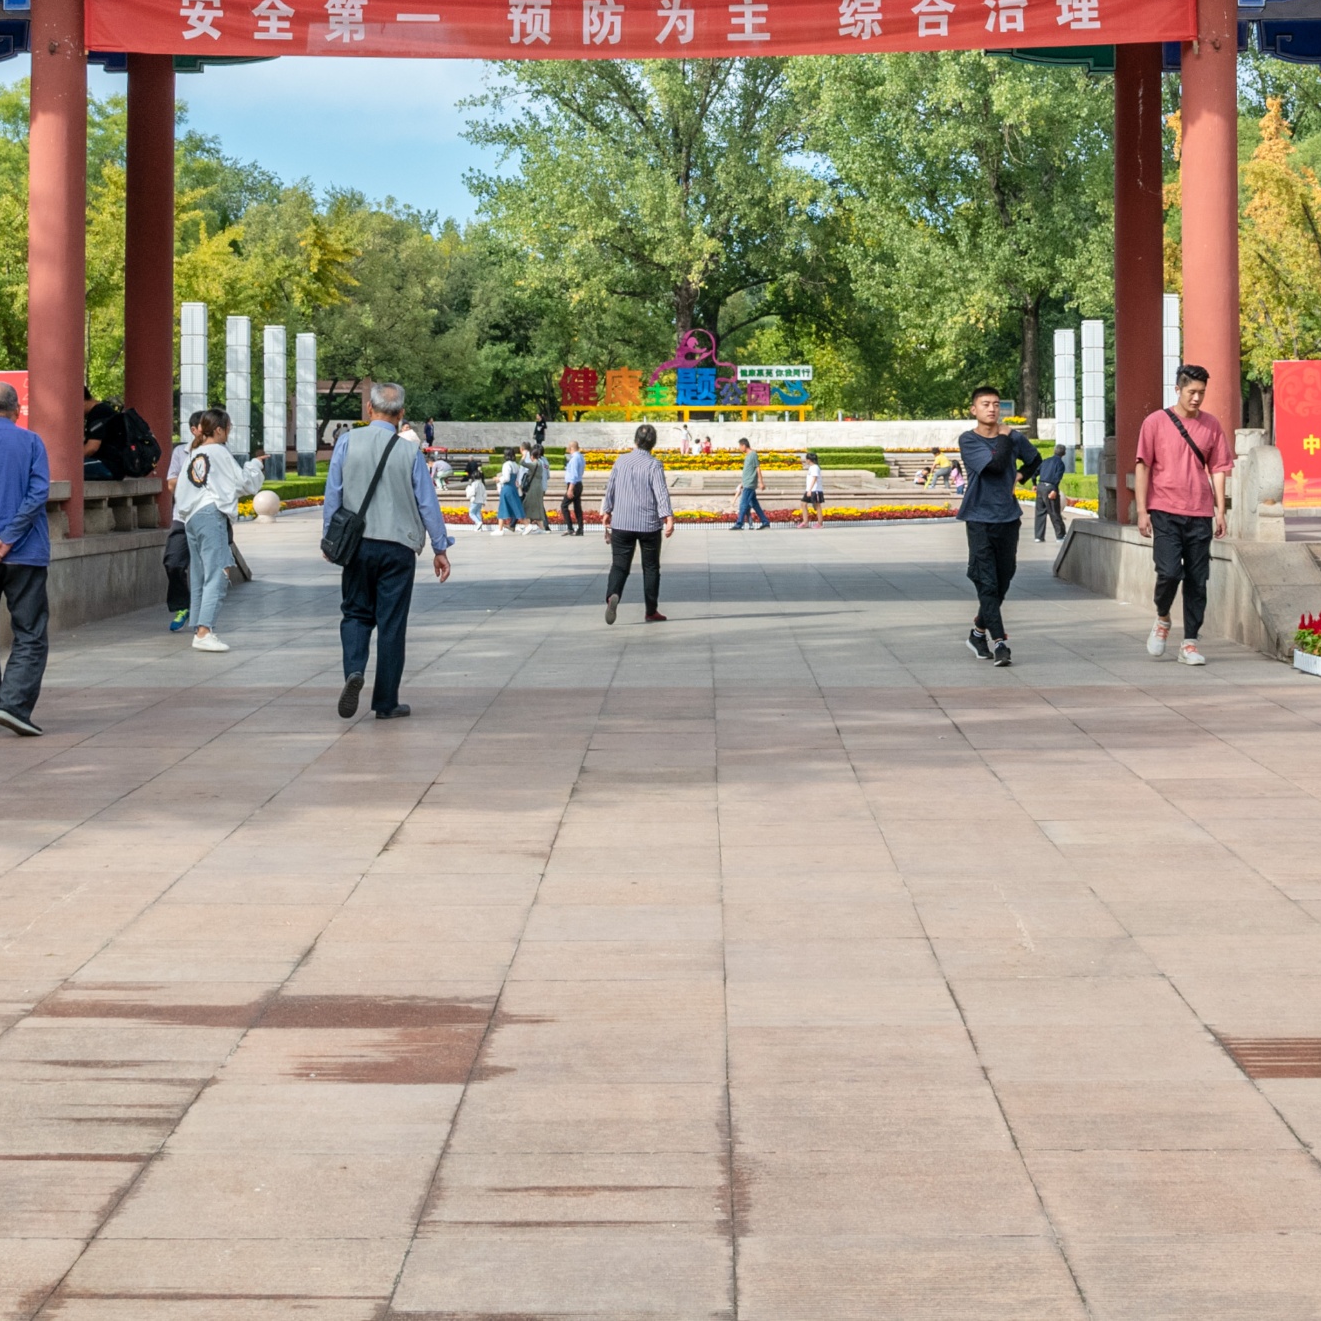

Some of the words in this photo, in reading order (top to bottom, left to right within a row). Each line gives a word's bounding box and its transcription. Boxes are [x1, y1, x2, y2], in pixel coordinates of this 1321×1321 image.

[558, 366, 772, 406] 健康主题公园
